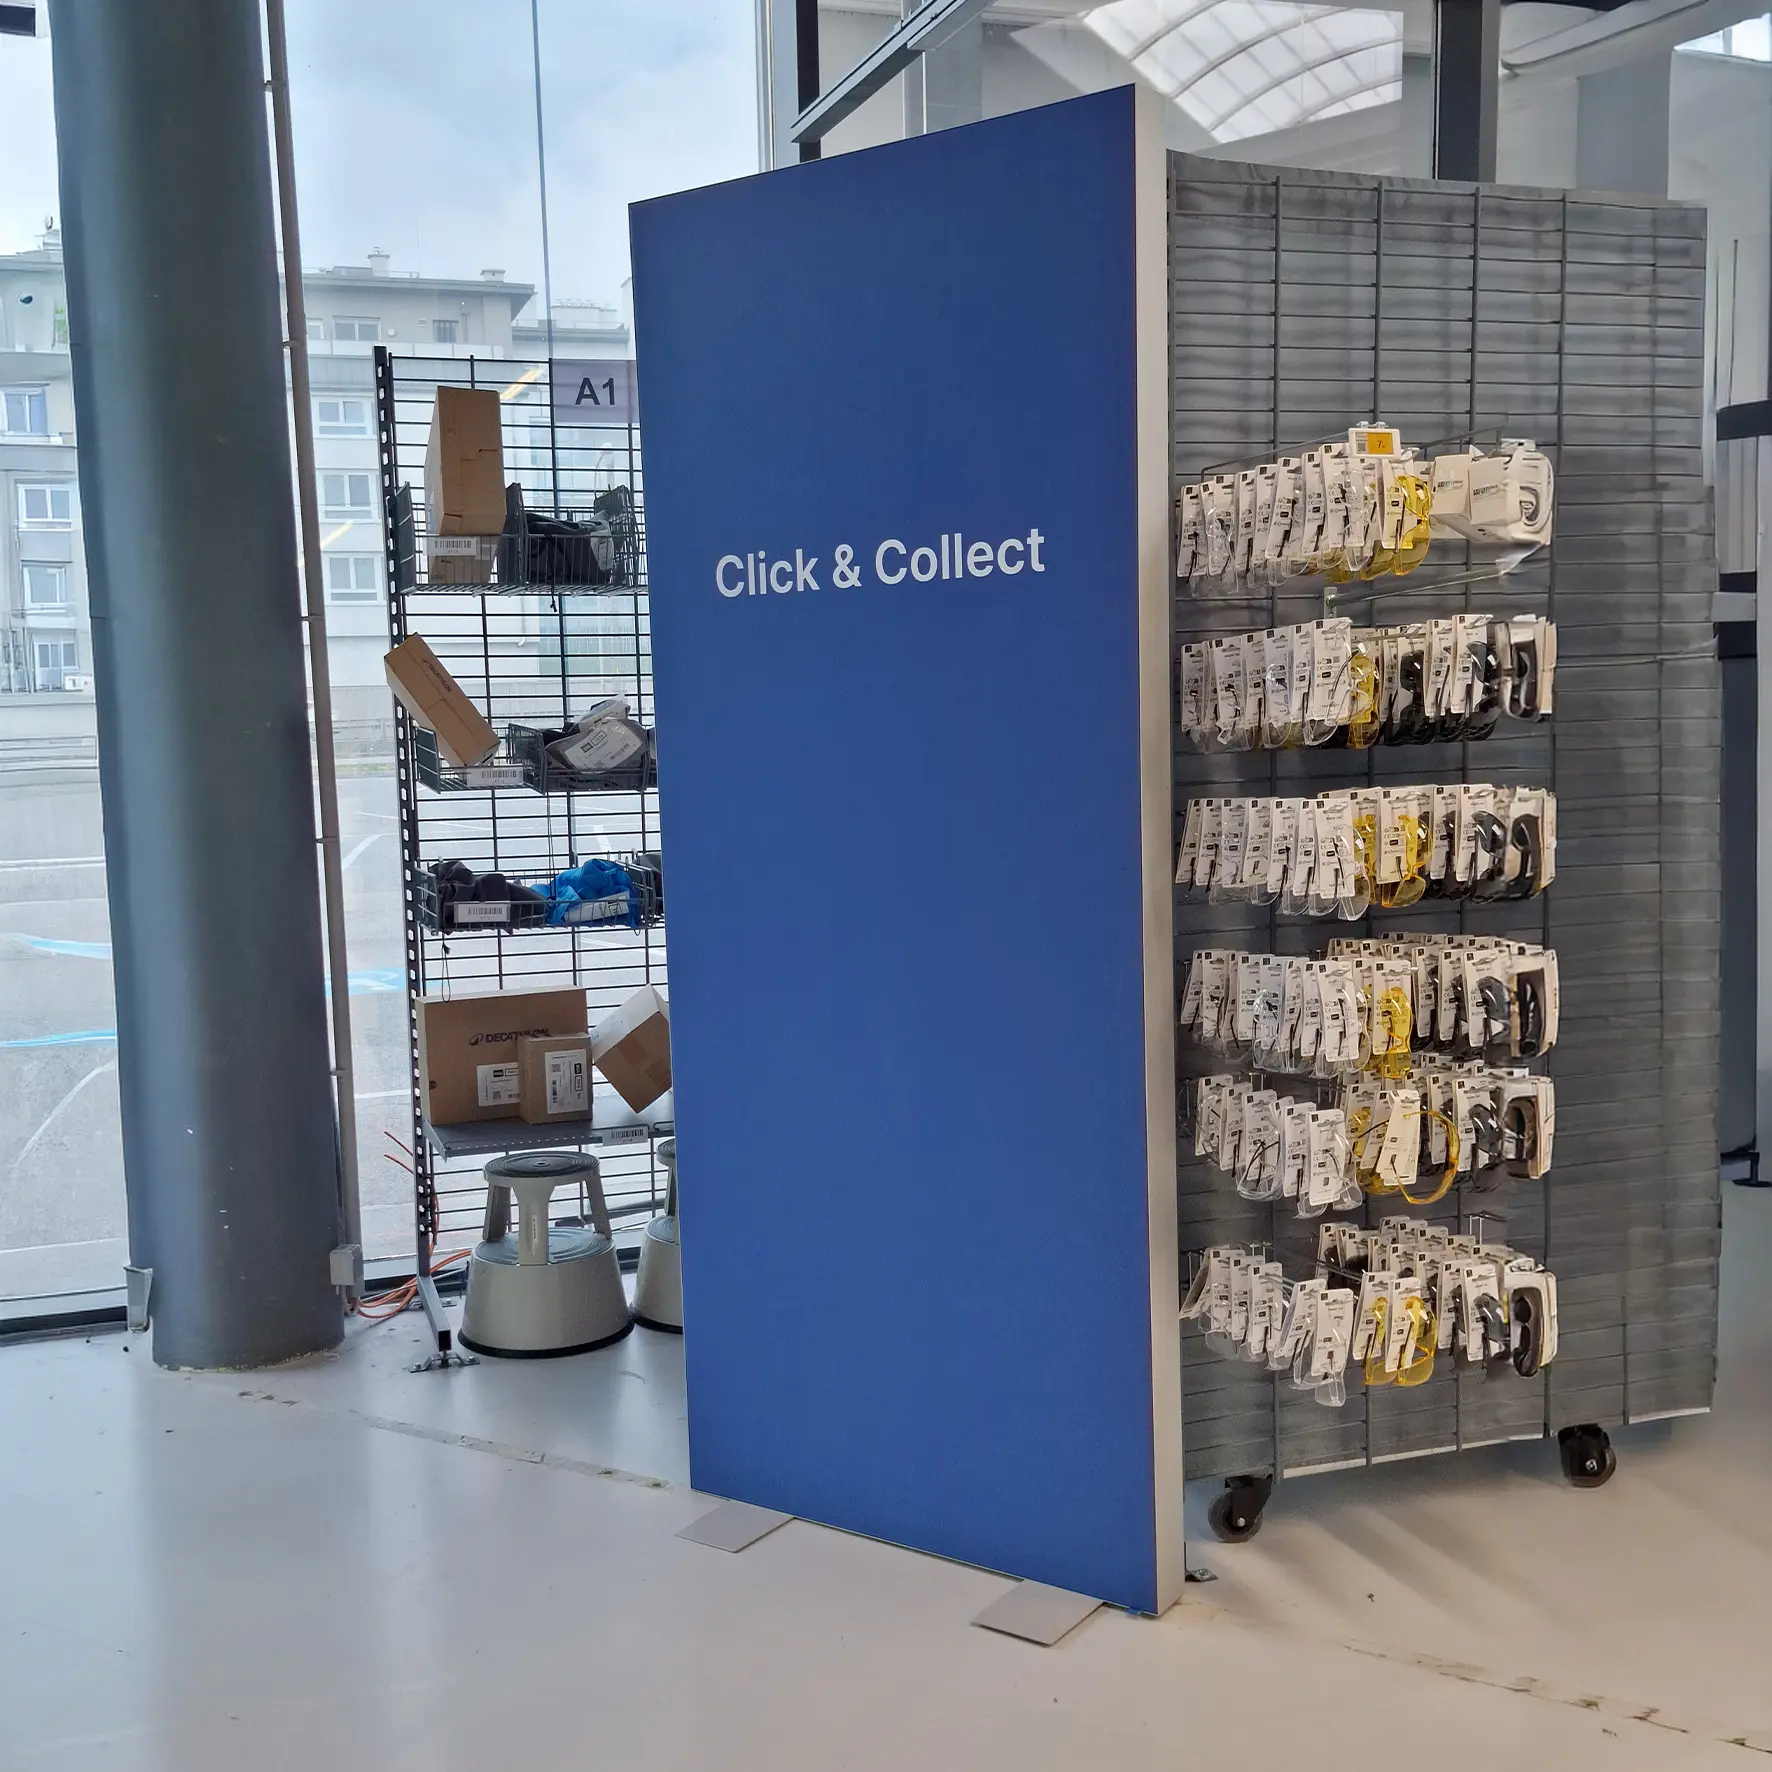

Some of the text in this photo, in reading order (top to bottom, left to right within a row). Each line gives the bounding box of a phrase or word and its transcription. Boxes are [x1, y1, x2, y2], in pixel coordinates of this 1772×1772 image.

[575, 377, 615, 406] A1
[715, 528, 1046, 598] Click & Collect
